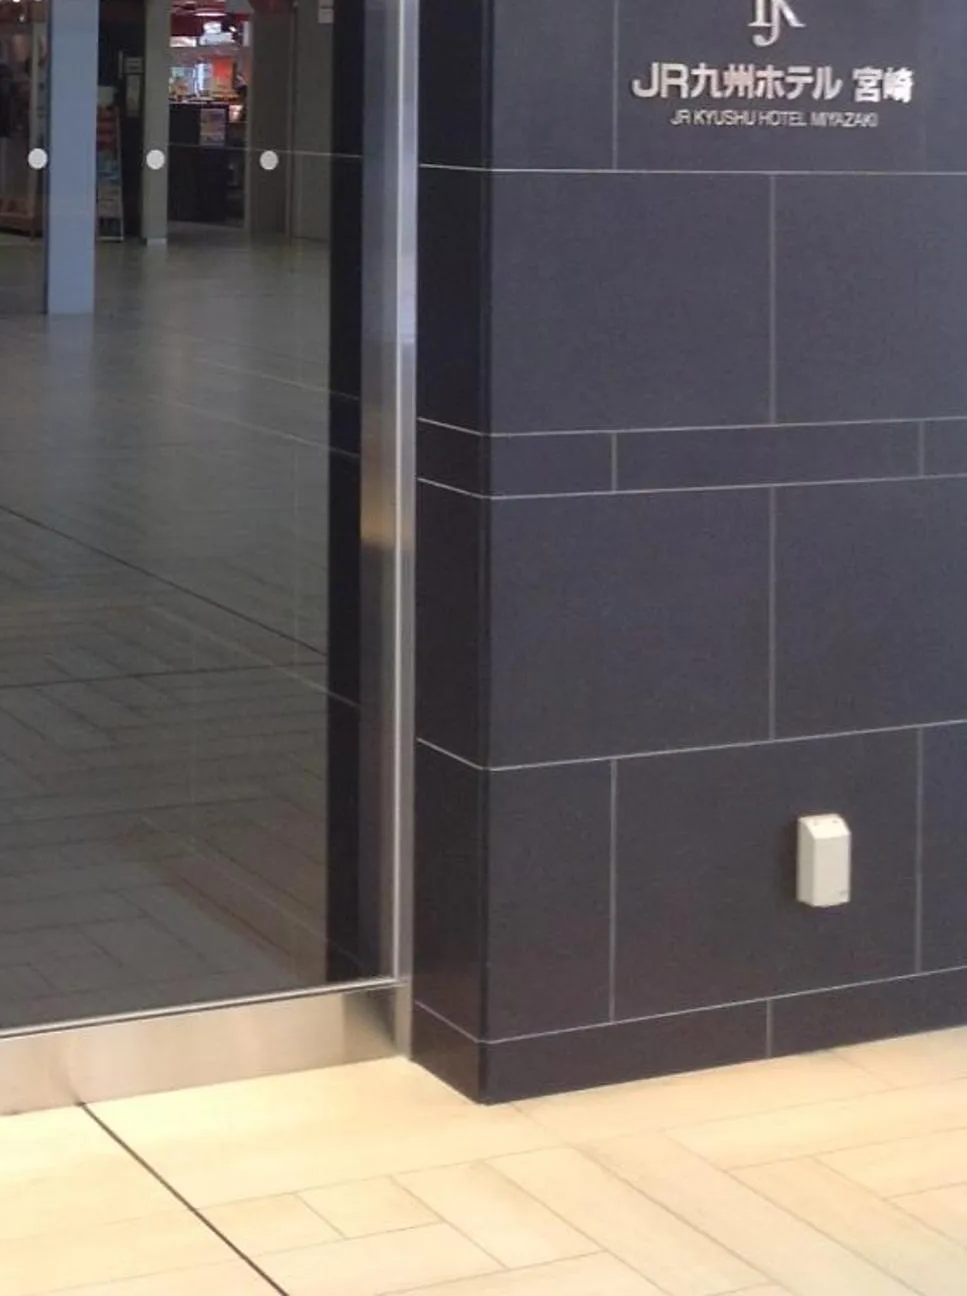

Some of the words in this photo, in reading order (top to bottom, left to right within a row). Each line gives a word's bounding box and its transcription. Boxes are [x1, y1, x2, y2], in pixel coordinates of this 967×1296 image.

[632, 62, 843, 100] JR九州ホテル
[852, 66, 915, 104] 宮崎
[694, 109, 757, 126] KYUSHU
[759, 110, 807, 127] HOTEL
[810, 111, 879, 128] MIYAZAKI
